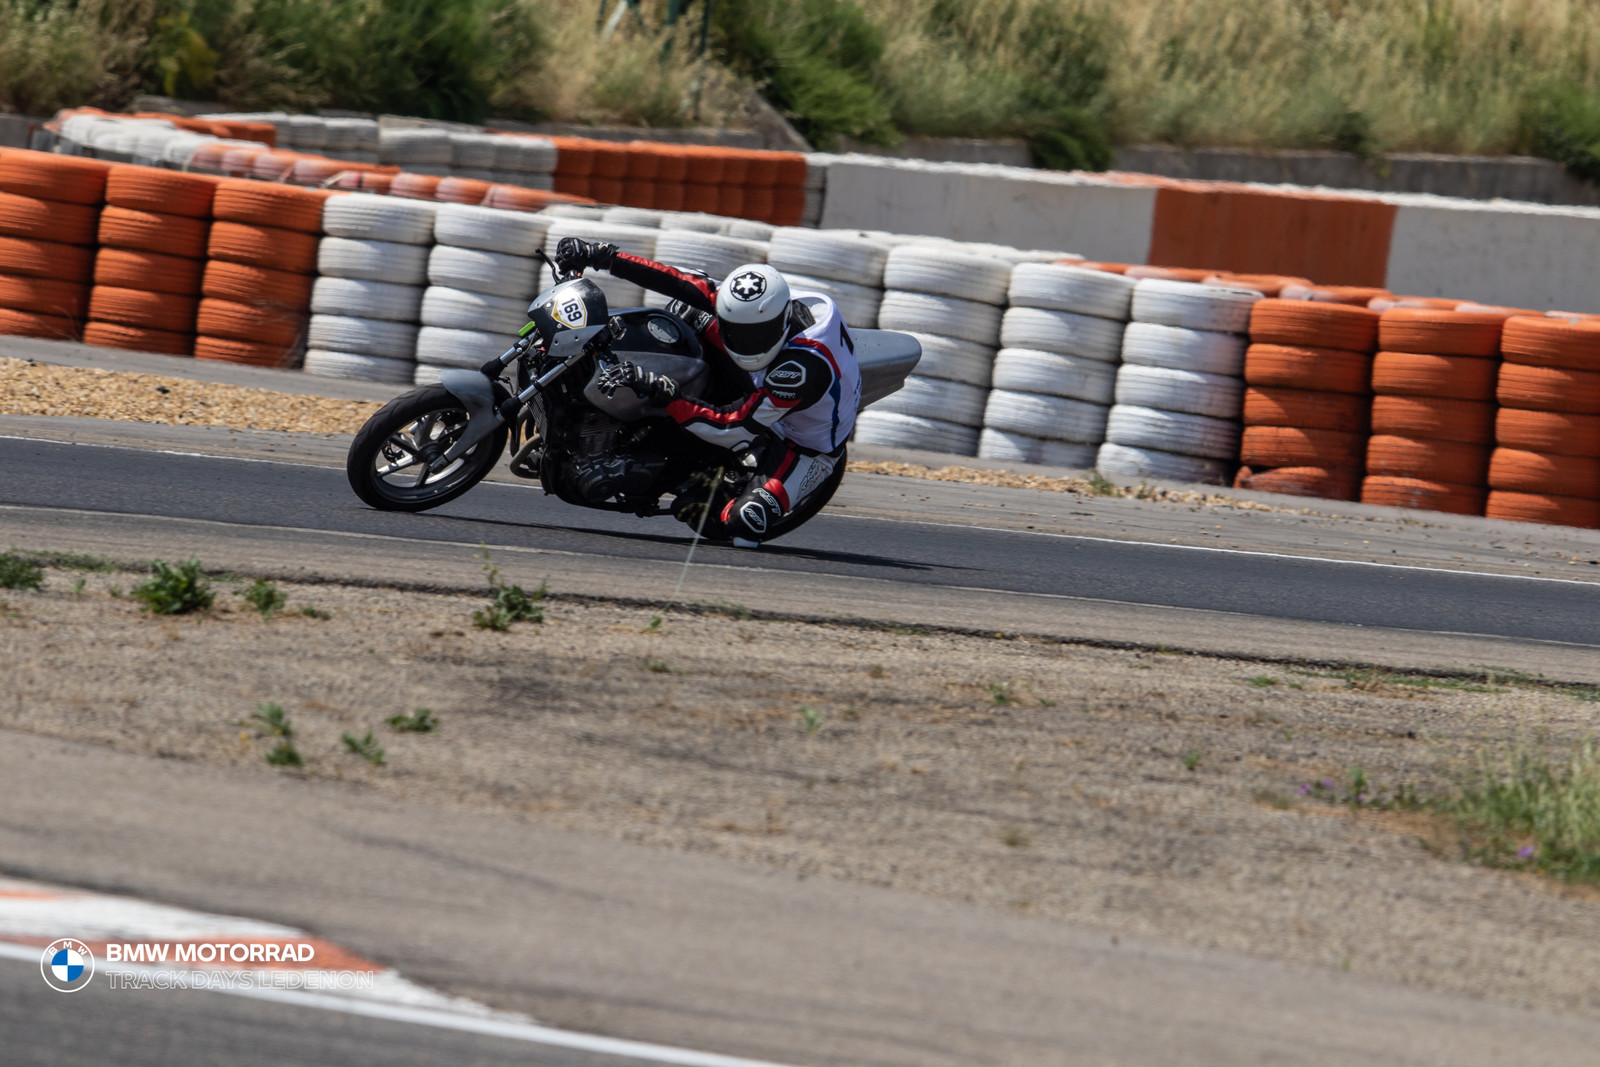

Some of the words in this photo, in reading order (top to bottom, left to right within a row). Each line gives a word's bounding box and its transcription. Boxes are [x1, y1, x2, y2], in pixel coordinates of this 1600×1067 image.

[561, 298, 583, 322] 169
[770, 370, 801, 379] RST
[752, 487, 782, 517] RST
